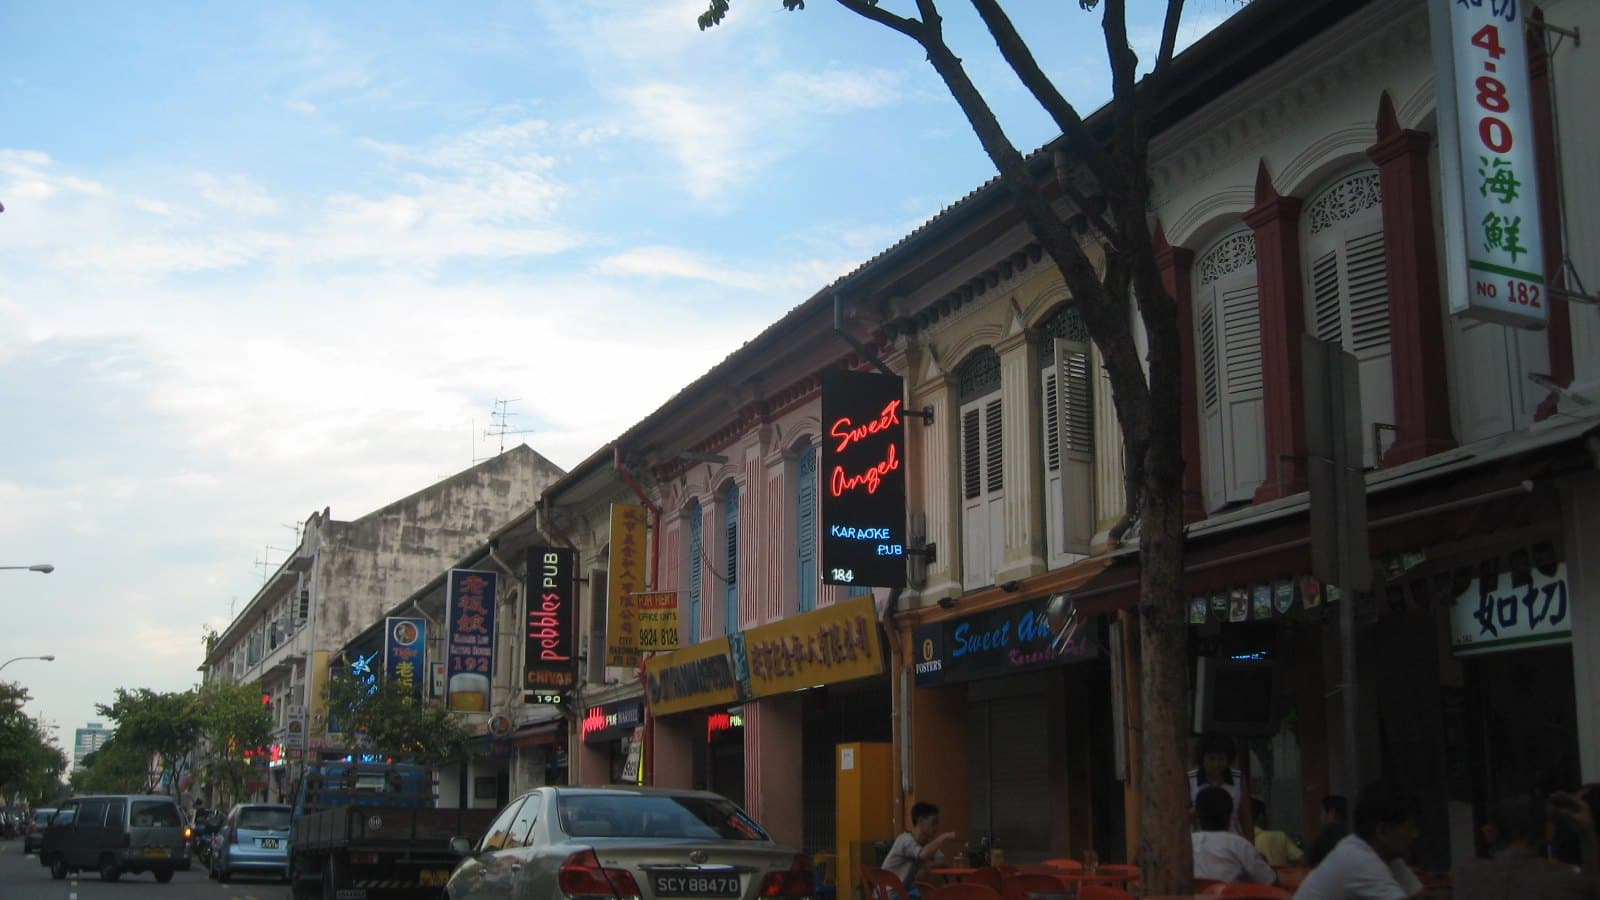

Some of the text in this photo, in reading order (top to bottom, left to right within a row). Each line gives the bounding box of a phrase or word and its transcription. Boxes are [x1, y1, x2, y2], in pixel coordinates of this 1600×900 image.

[1478, 155, 1528, 265] 海鮮
[1506, 279, 1542, 309] 182
[830, 398, 902, 454] Sweet
[831, 442, 900, 498] Angel
[830, 524, 892, 541] KARAOKE
[876, 543, 904, 557] PUB
[830, 568, 855, 583] 184
[528, 552, 571, 662] PUB pebbles
[1473, 579, 1567, 638] 如切
[639, 628, 679, 647] 9824 8124
[951, 616, 1012, 658] Sweet
[453, 657, 490, 672] 192
[536, 694, 562, 704] 190
[657, 878, 739, 892] SCY8847D
